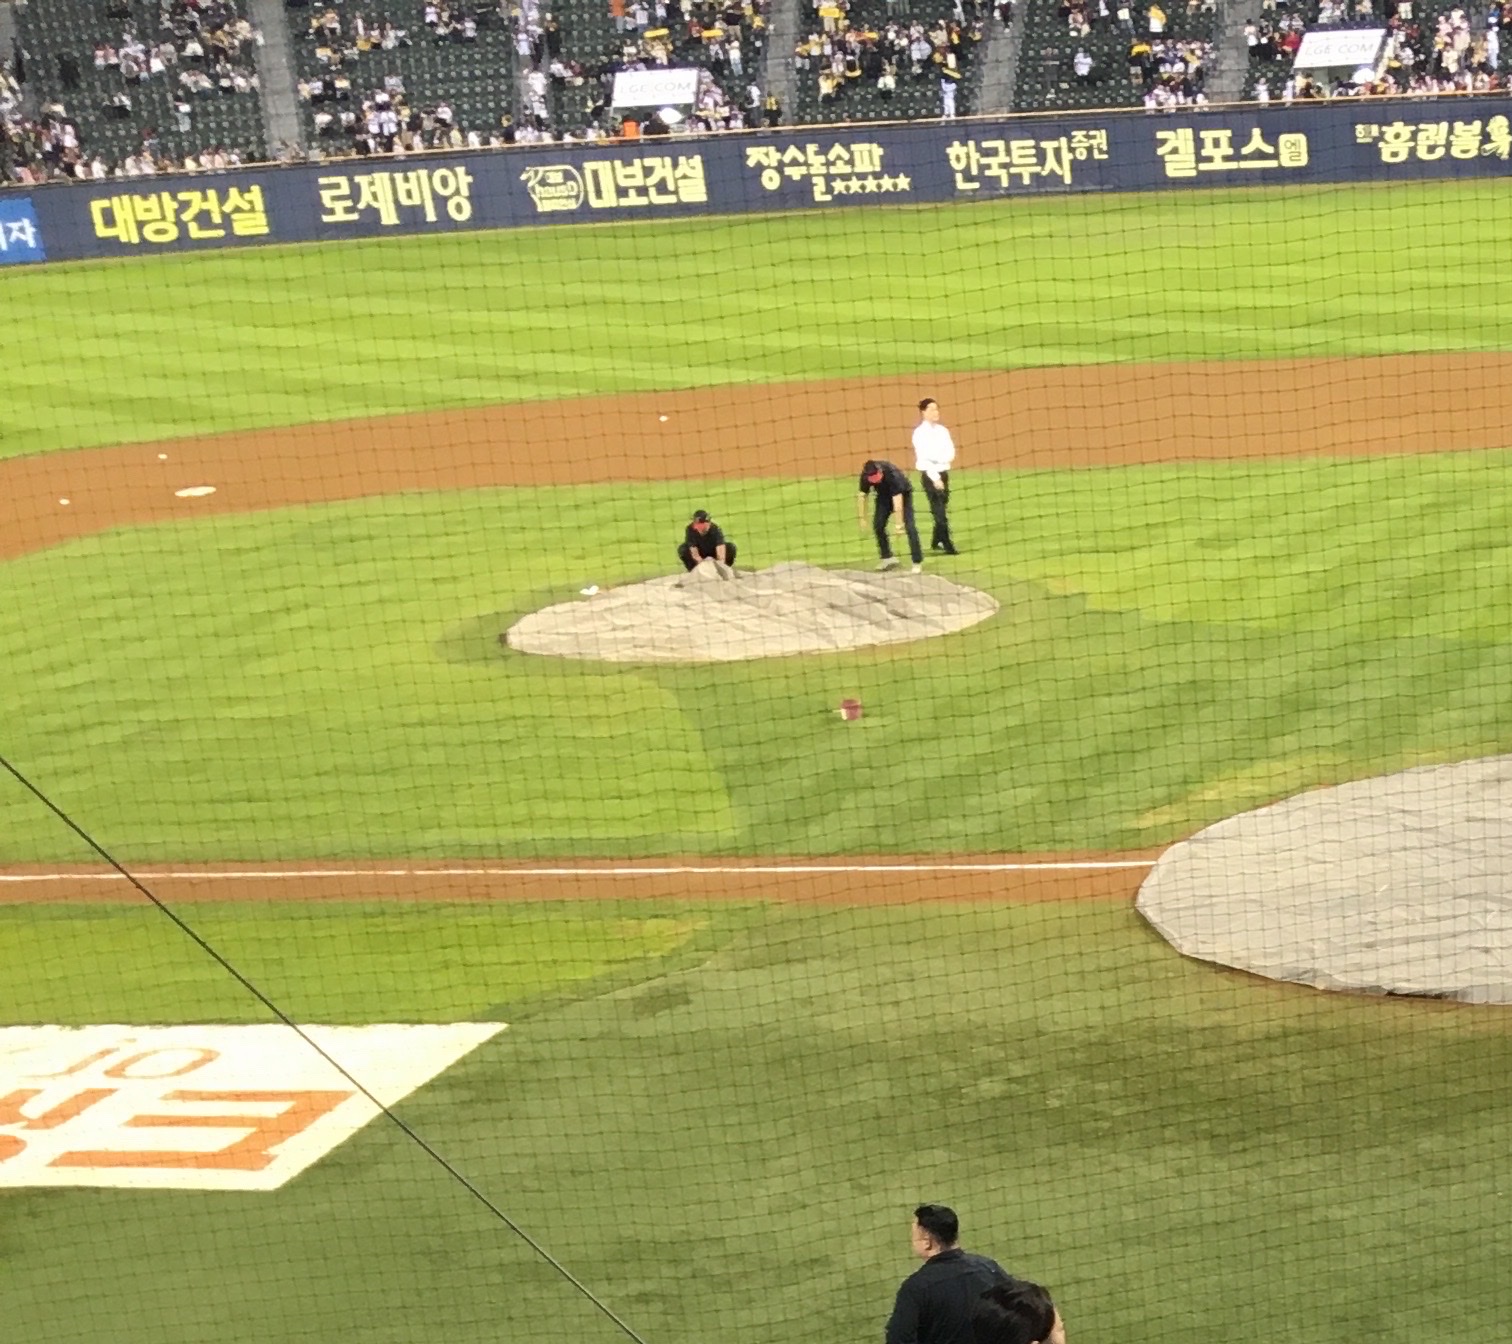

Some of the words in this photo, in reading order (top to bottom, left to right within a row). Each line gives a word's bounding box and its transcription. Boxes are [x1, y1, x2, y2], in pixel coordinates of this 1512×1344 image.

[1378, 121, 1483, 162] 홈런볼
[317, 166, 472, 225] 로제비앙
[583, 155, 708, 208] 대보건설
[90, 185, 269, 244] 대방건설
